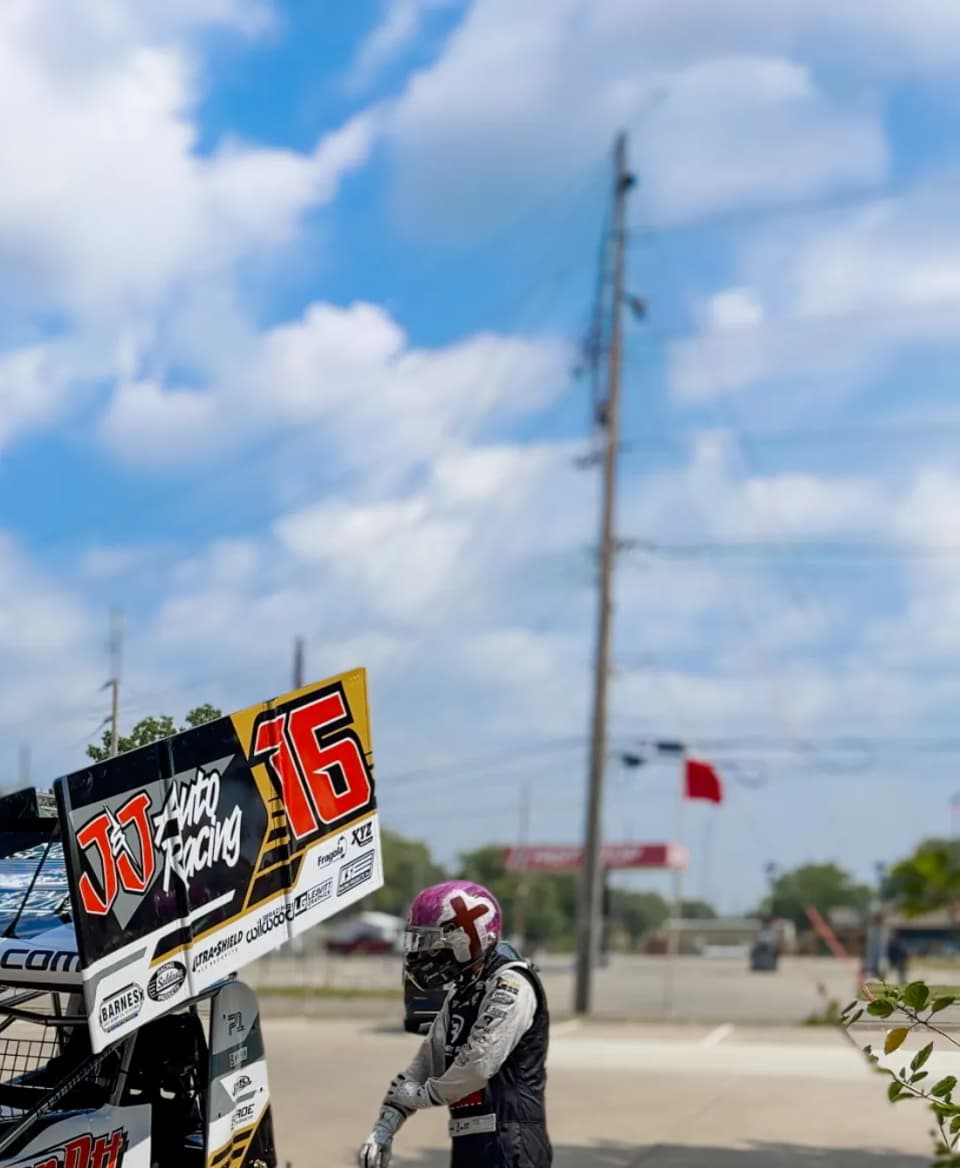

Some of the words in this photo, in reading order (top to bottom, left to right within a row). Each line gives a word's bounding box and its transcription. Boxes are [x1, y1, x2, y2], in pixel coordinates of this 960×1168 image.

[254, 691, 372, 840] 16
[155, 770, 220, 848] Auto
[351, 822, 372, 846] XYZ
[162, 806, 242, 892] Racing
[101, 989, 140, 1021] BARNES
